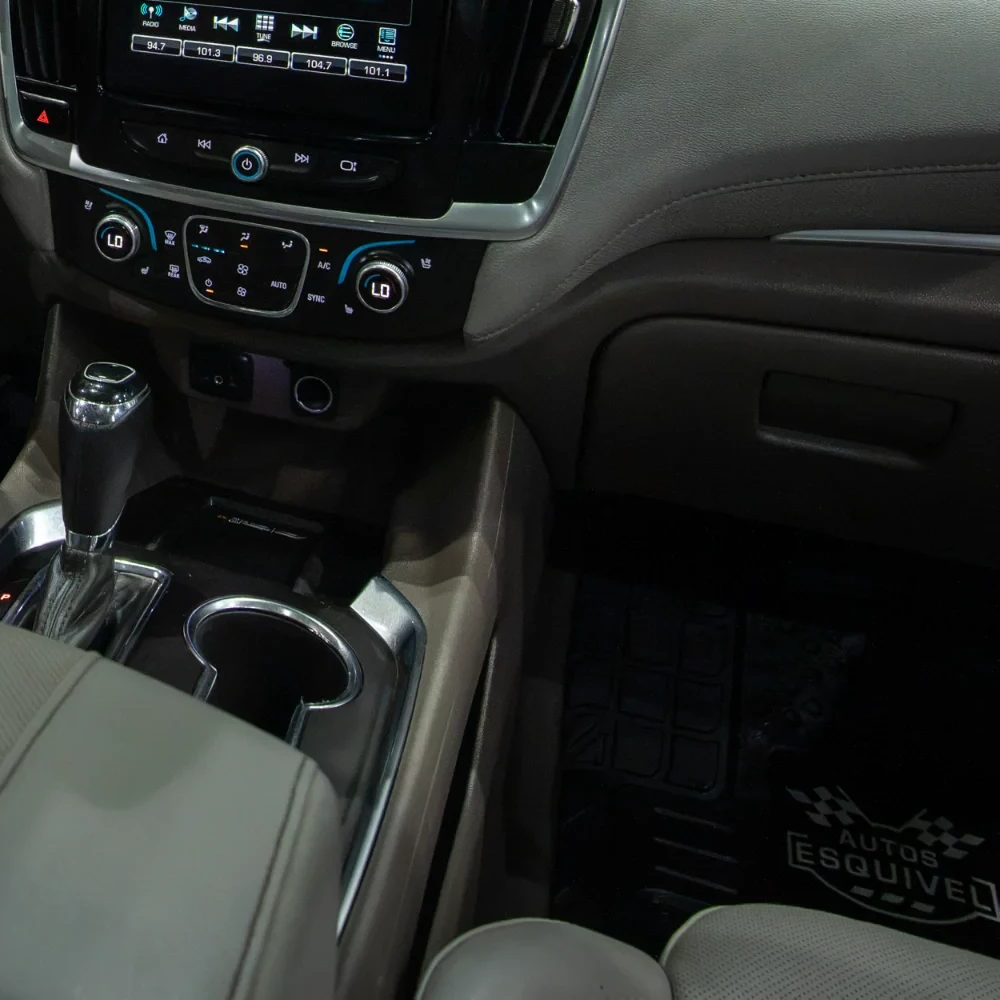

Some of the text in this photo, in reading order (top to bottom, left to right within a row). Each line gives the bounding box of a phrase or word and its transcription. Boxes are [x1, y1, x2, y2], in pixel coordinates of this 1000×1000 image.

[142, 20, 160, 28] RADIO
[178, 24, 197, 32] MEDIA
[146, 40, 166, 52] 94.7
[331, 40, 358, 50] BROWSE
[376, 46, 396, 54] MENU
[196, 46, 221, 58] 101.3
[252, 52, 273, 64] 96.9
[306, 59, 332, 71] 104.7
[363, 65, 391, 78] 101.1
[317, 260, 332, 271] A/C
[270, 280, 287, 290] AUTO
[307, 293, 326, 303] SYNC
[0, 593, 12, 601] P
[839, 828, 939, 869] AUTOS
[795, 840, 993, 913] ESQUIVEL
